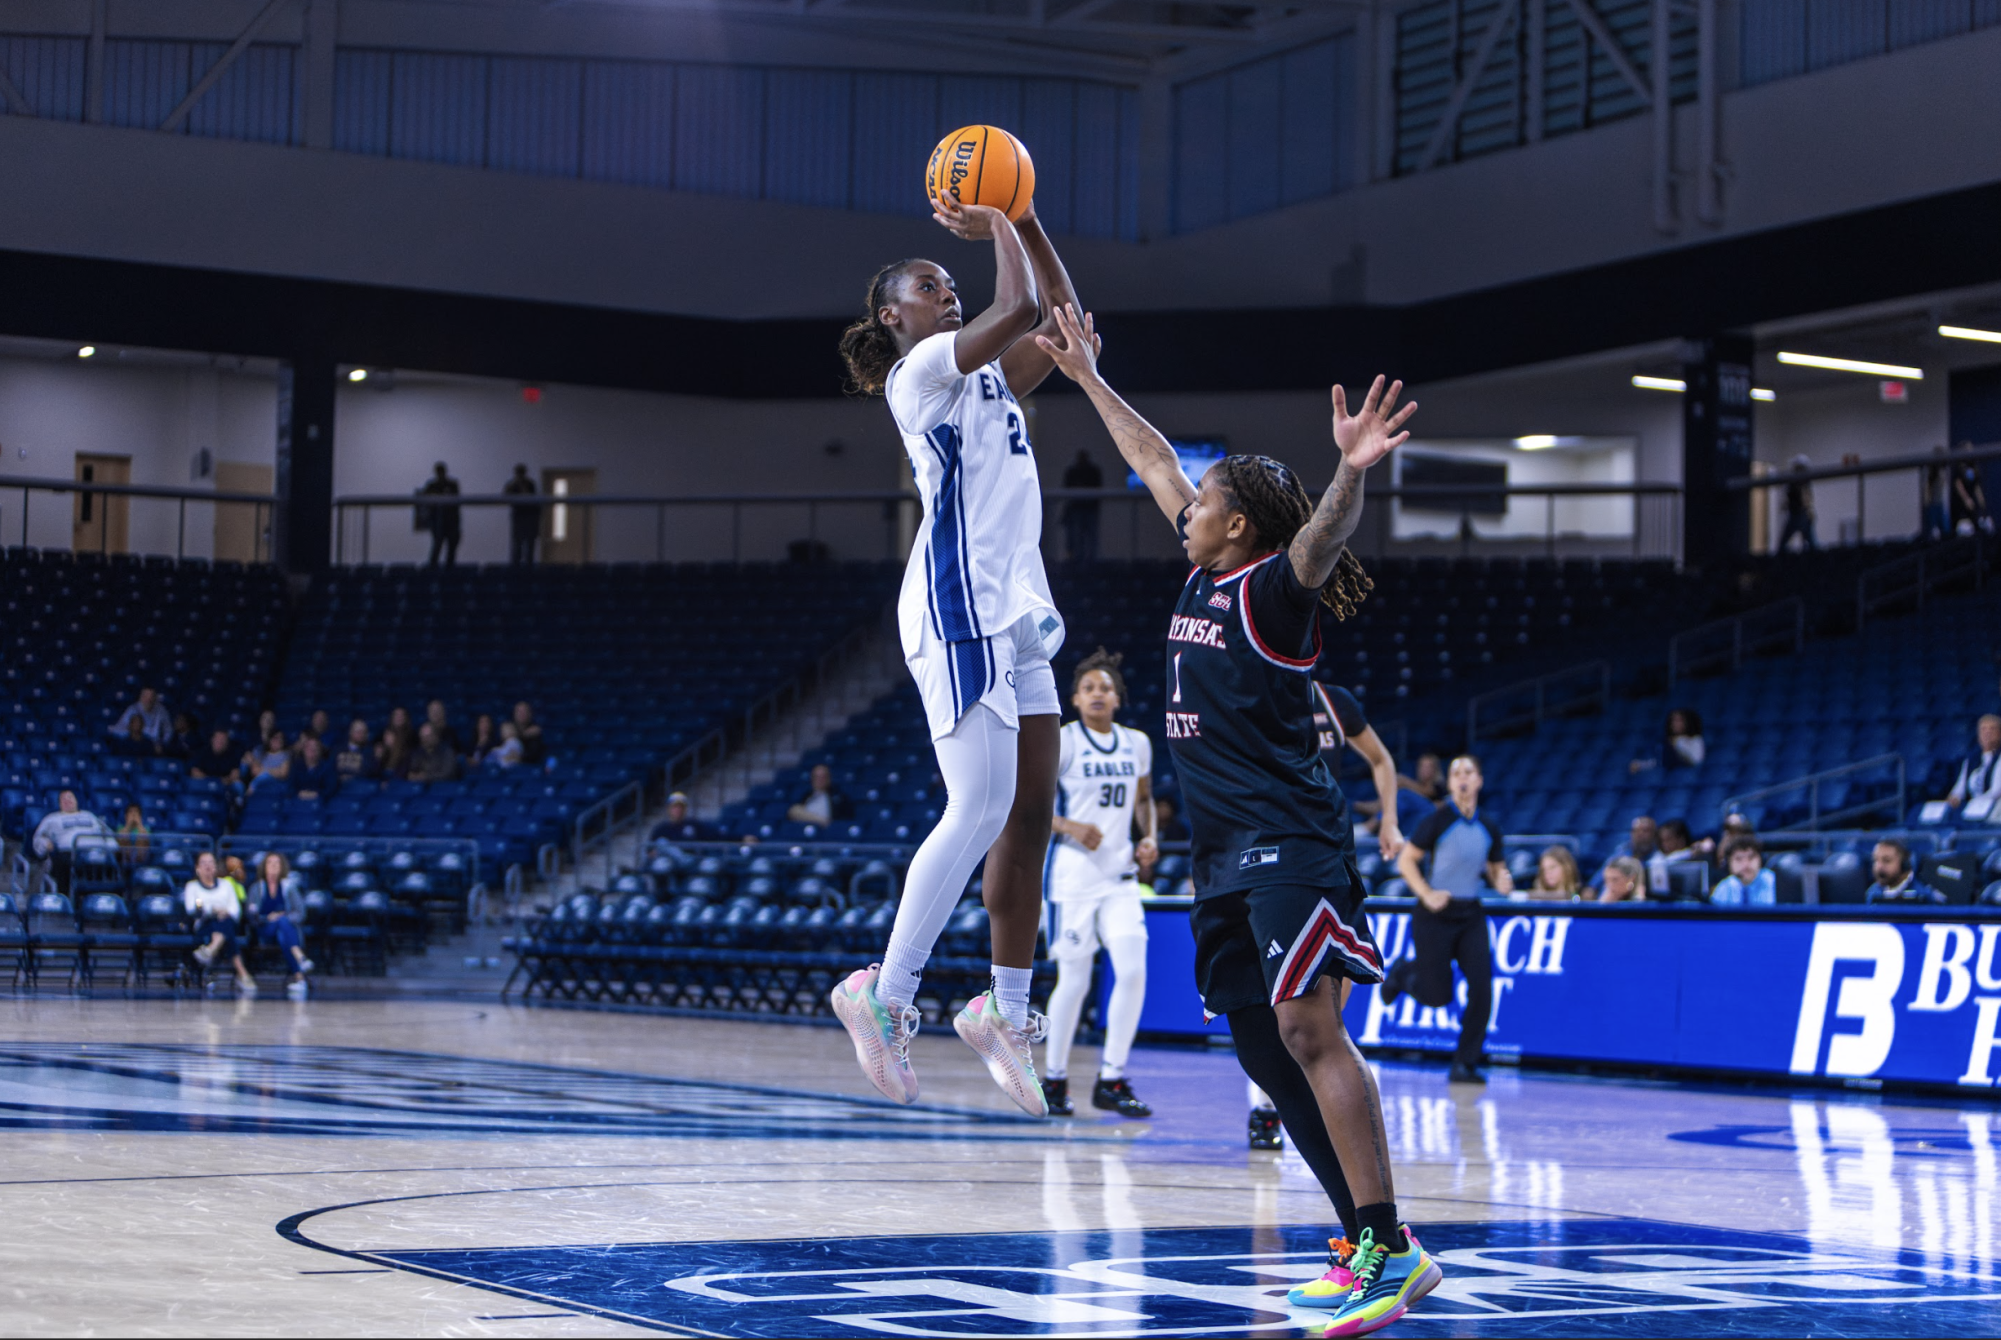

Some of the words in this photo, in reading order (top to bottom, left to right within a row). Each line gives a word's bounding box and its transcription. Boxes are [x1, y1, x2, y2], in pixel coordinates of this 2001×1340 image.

[950, 141, 977, 203] Wilso
[1083, 762, 1135, 777] EAGLES
[1098, 783, 1127, 808] 30
